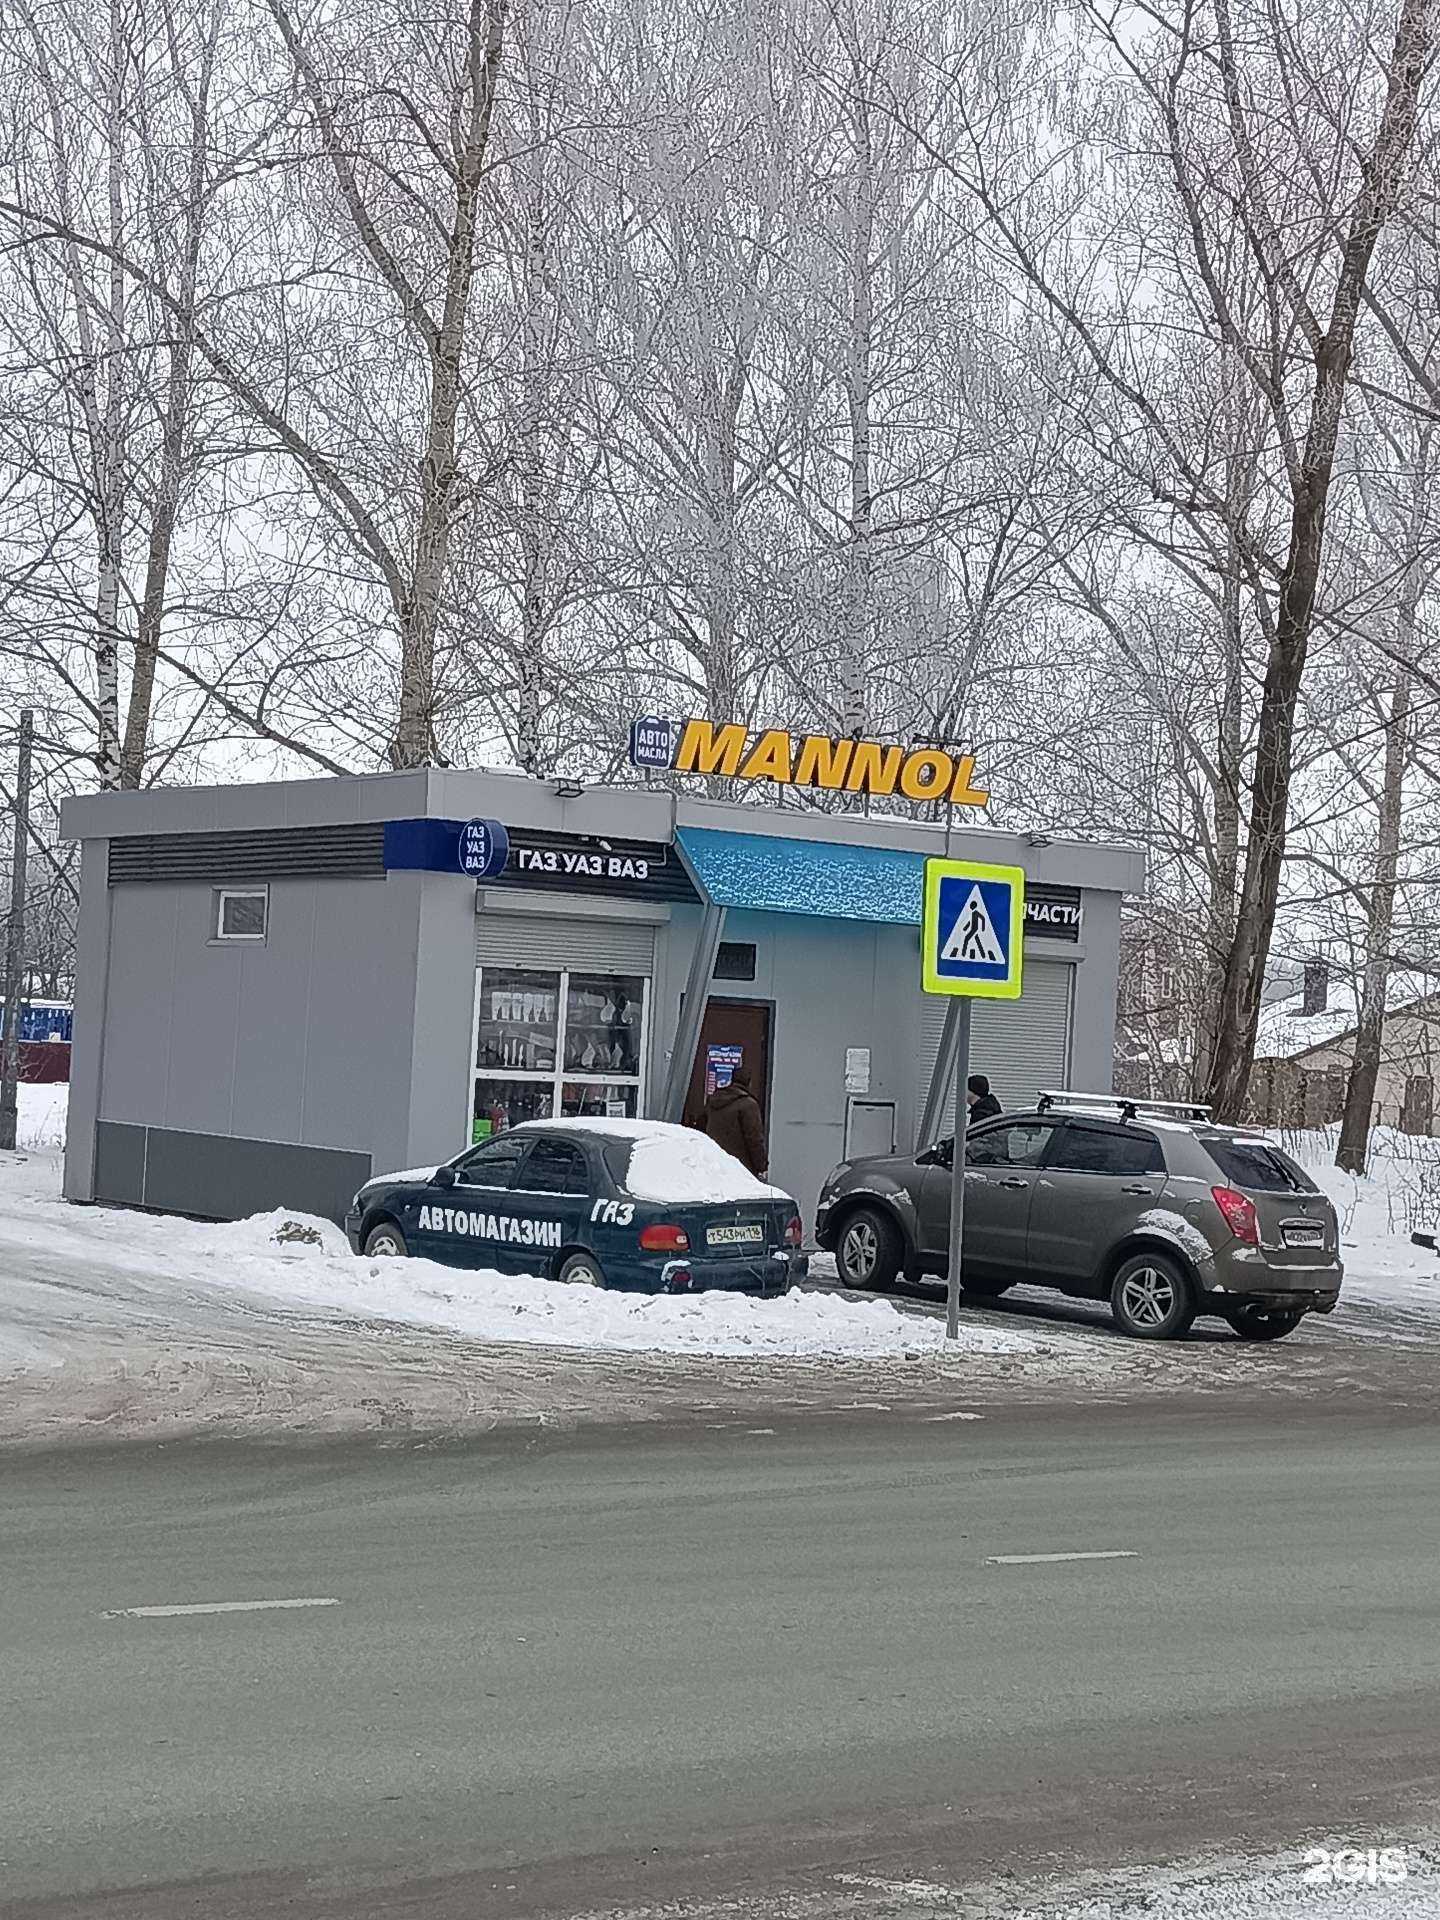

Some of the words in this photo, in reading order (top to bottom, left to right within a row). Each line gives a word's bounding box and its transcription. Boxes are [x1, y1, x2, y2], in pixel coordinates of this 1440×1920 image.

[638, 729, 668, 747] АВТО
[637, 745, 667, 761] МАСЛА
[675, 719, 989, 807] MANNOL
[467, 826, 485, 839] ГАЗ
[466, 841, 485, 854] УАЗ
[465, 856, 485, 869] ВАЗ
[518, 850, 557, 871] ГАЗ
[558, 853, 602, 875] УАЗ
[608, 857, 648, 879] ВАЗ
[590, 1198, 636, 1226] ГАЗ
[418, 1205, 563, 1248] АВТОМАГАЗИН
